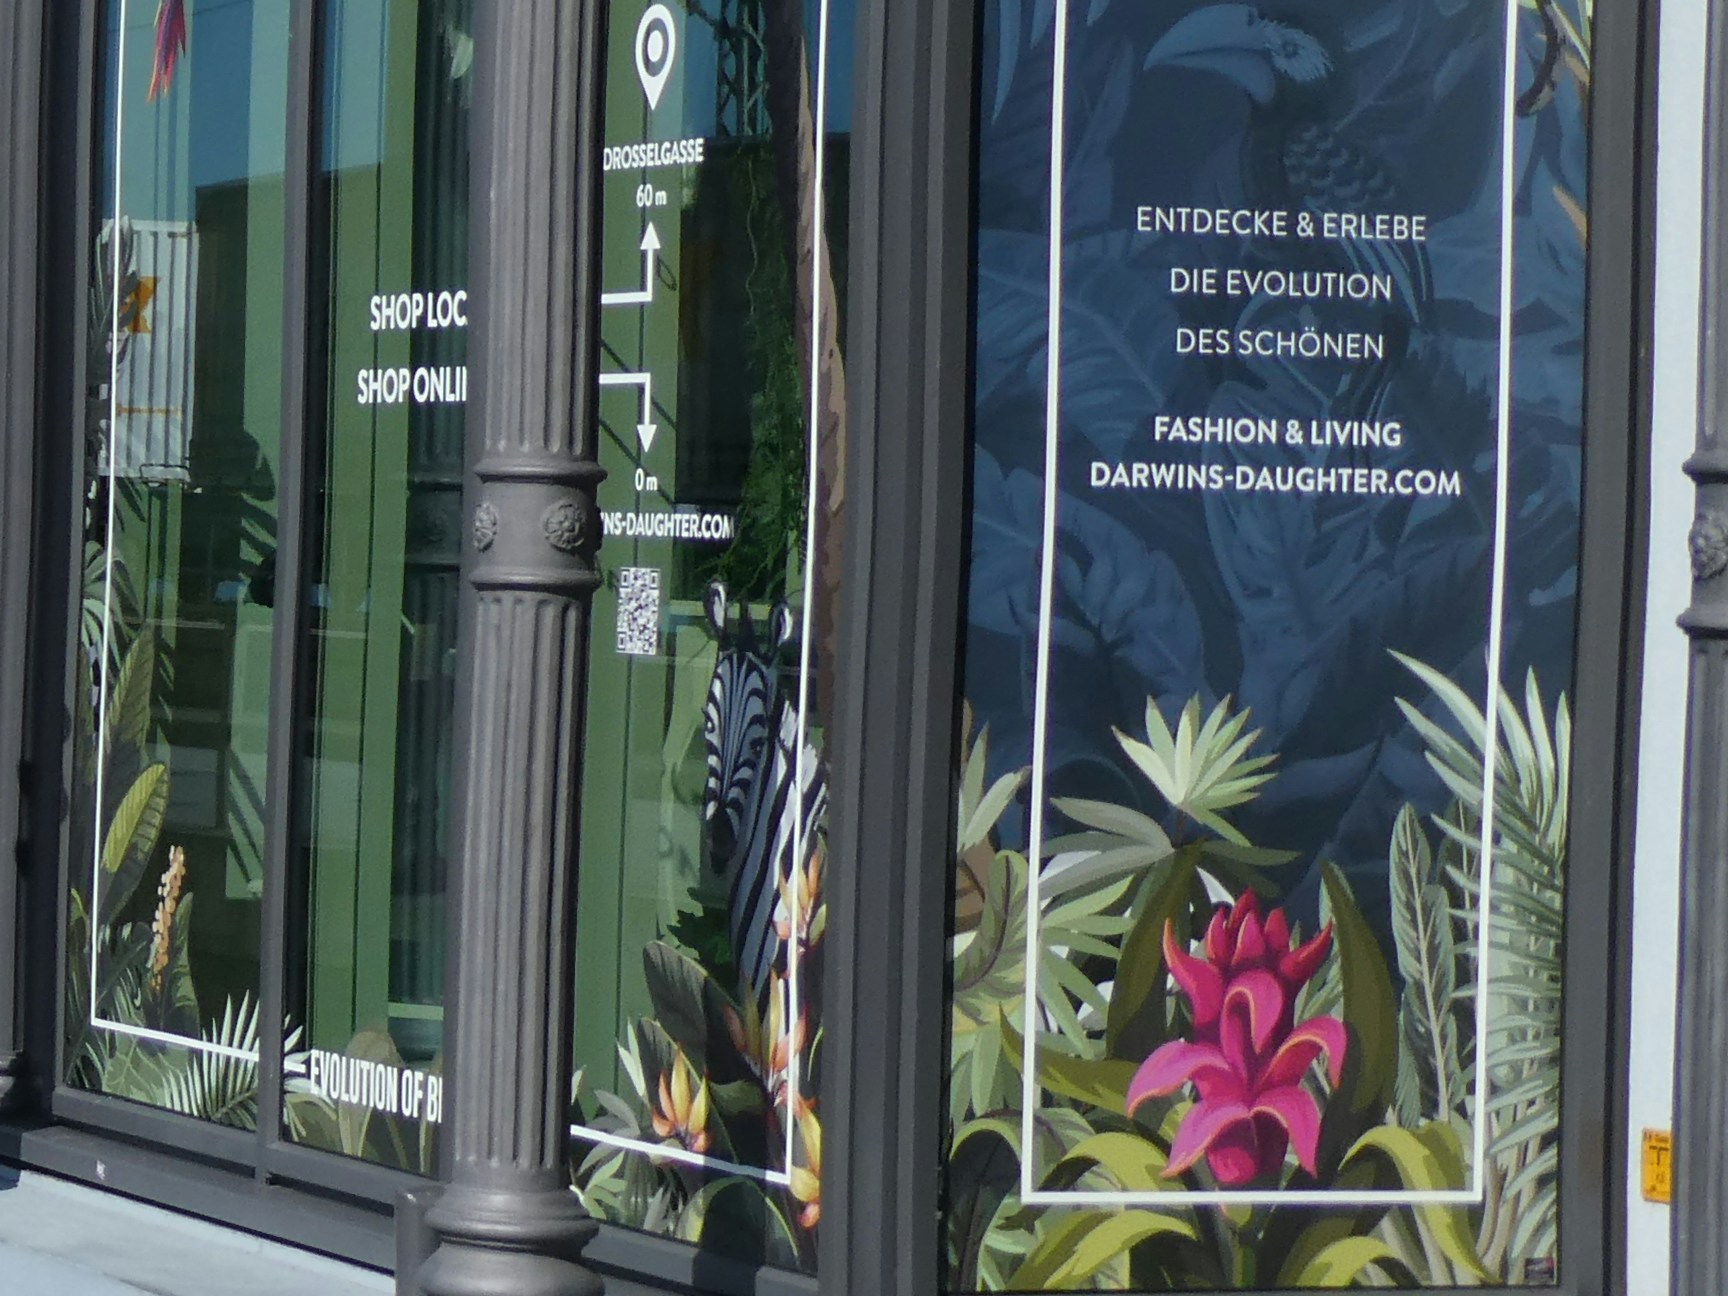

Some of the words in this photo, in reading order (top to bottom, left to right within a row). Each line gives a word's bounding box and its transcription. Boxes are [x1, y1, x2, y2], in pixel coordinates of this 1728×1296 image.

[603, 138, 704, 171] DROSSELGASSE
[636, 184, 653, 207] 60
[655, 190, 667, 205] m
[1136, 206, 1288, 236] ENTDECKE
[1296, 212, 1314, 238] &
[1323, 213, 1426, 241] ERLEBE
[1170, 268, 1217, 294] DIE
[1227, 269, 1392, 301] EVOLUTION
[370, 292, 424, 330] SHOP
[427, 290, 468, 327] LOC
[1176, 328, 1230, 354] DES
[1238, 326, 1384, 360] SCHÖNEN
[357, 368, 411, 404] SHOP
[1154, 416, 1278, 444] FASHION
[1285, 420, 1304, 445] &
[1311, 420, 1402, 447] LIVING
[635, 468, 645, 491] 0
[646, 476, 658, 491] m
[1090, 461, 1461, 496] DARWINS-DAUGHTER.COM
[600, 512, 735, 539] NS-DAUGHTER.COM
[310, 1049, 398, 1113] EVOLUTION
[401, 1069, 424, 1118] OF
